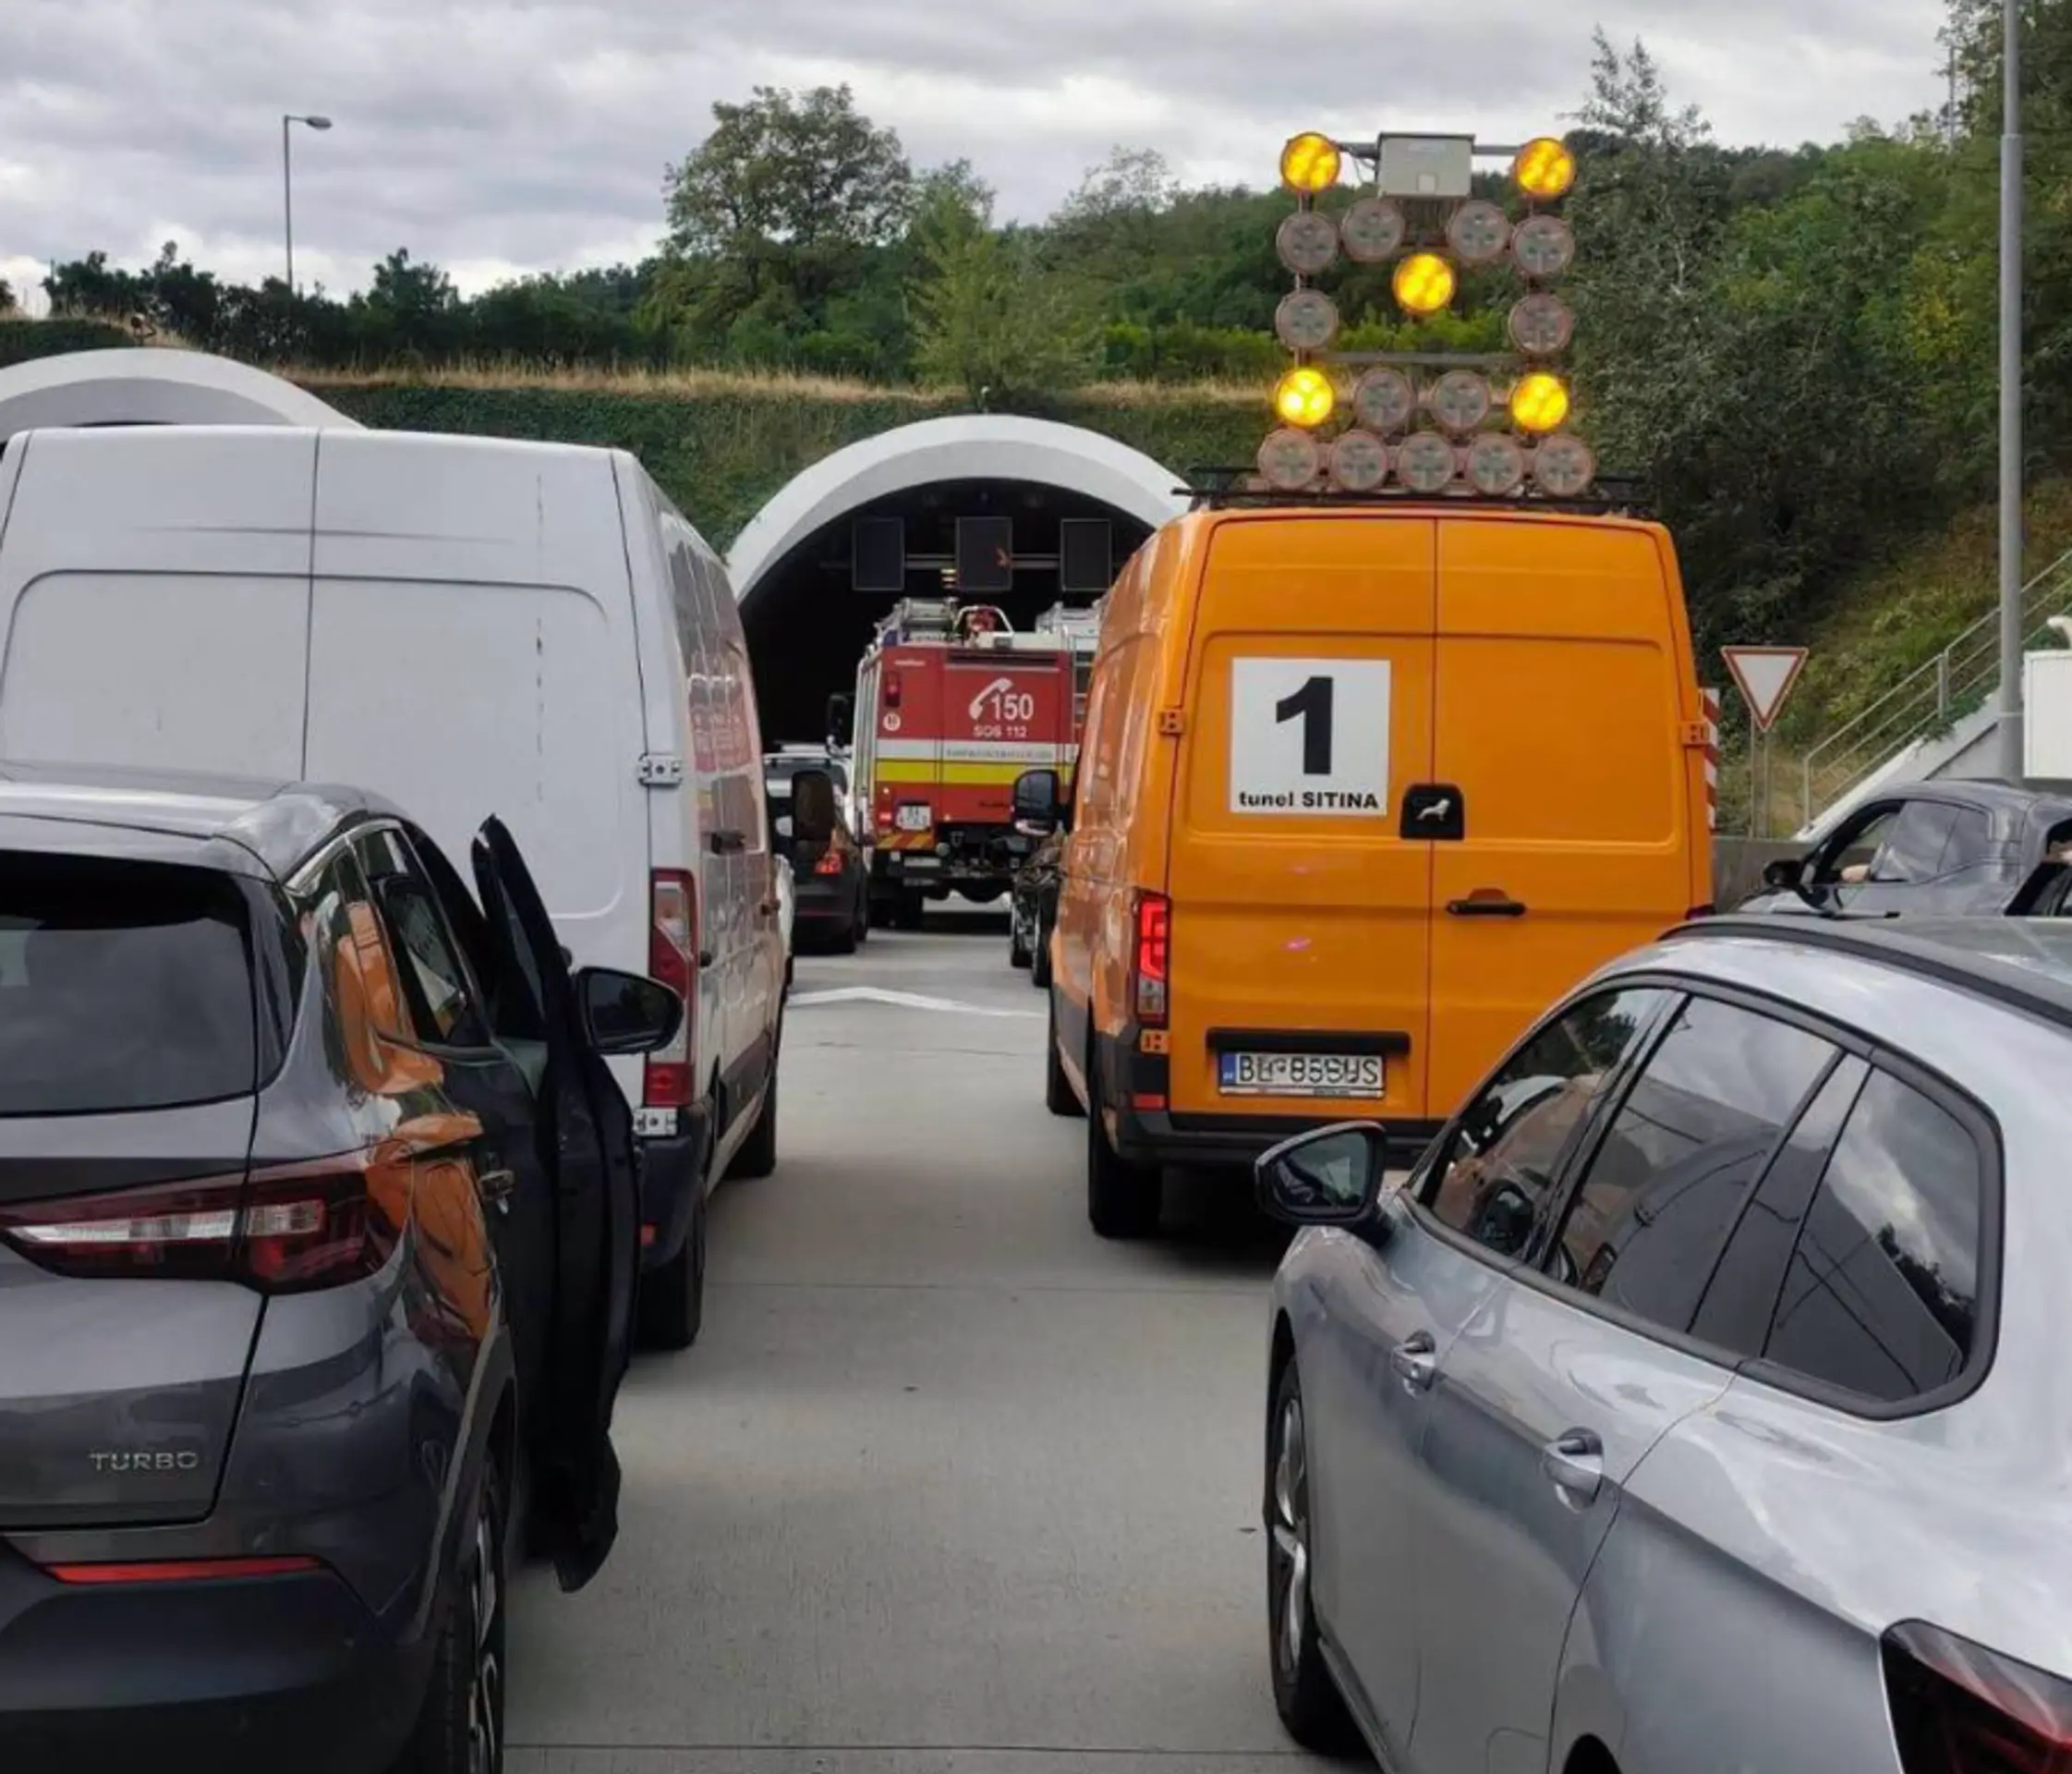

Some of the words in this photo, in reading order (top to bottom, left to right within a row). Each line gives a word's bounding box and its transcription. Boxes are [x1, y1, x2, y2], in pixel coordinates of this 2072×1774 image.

[990, 693, 1034, 721] 150
[1276, 675, 1333, 774] 1
[1239, 791, 1293, 807] tunel
[1302, 791, 1380, 808] SITINA
[90, 1452, 199, 1471] TURBO
